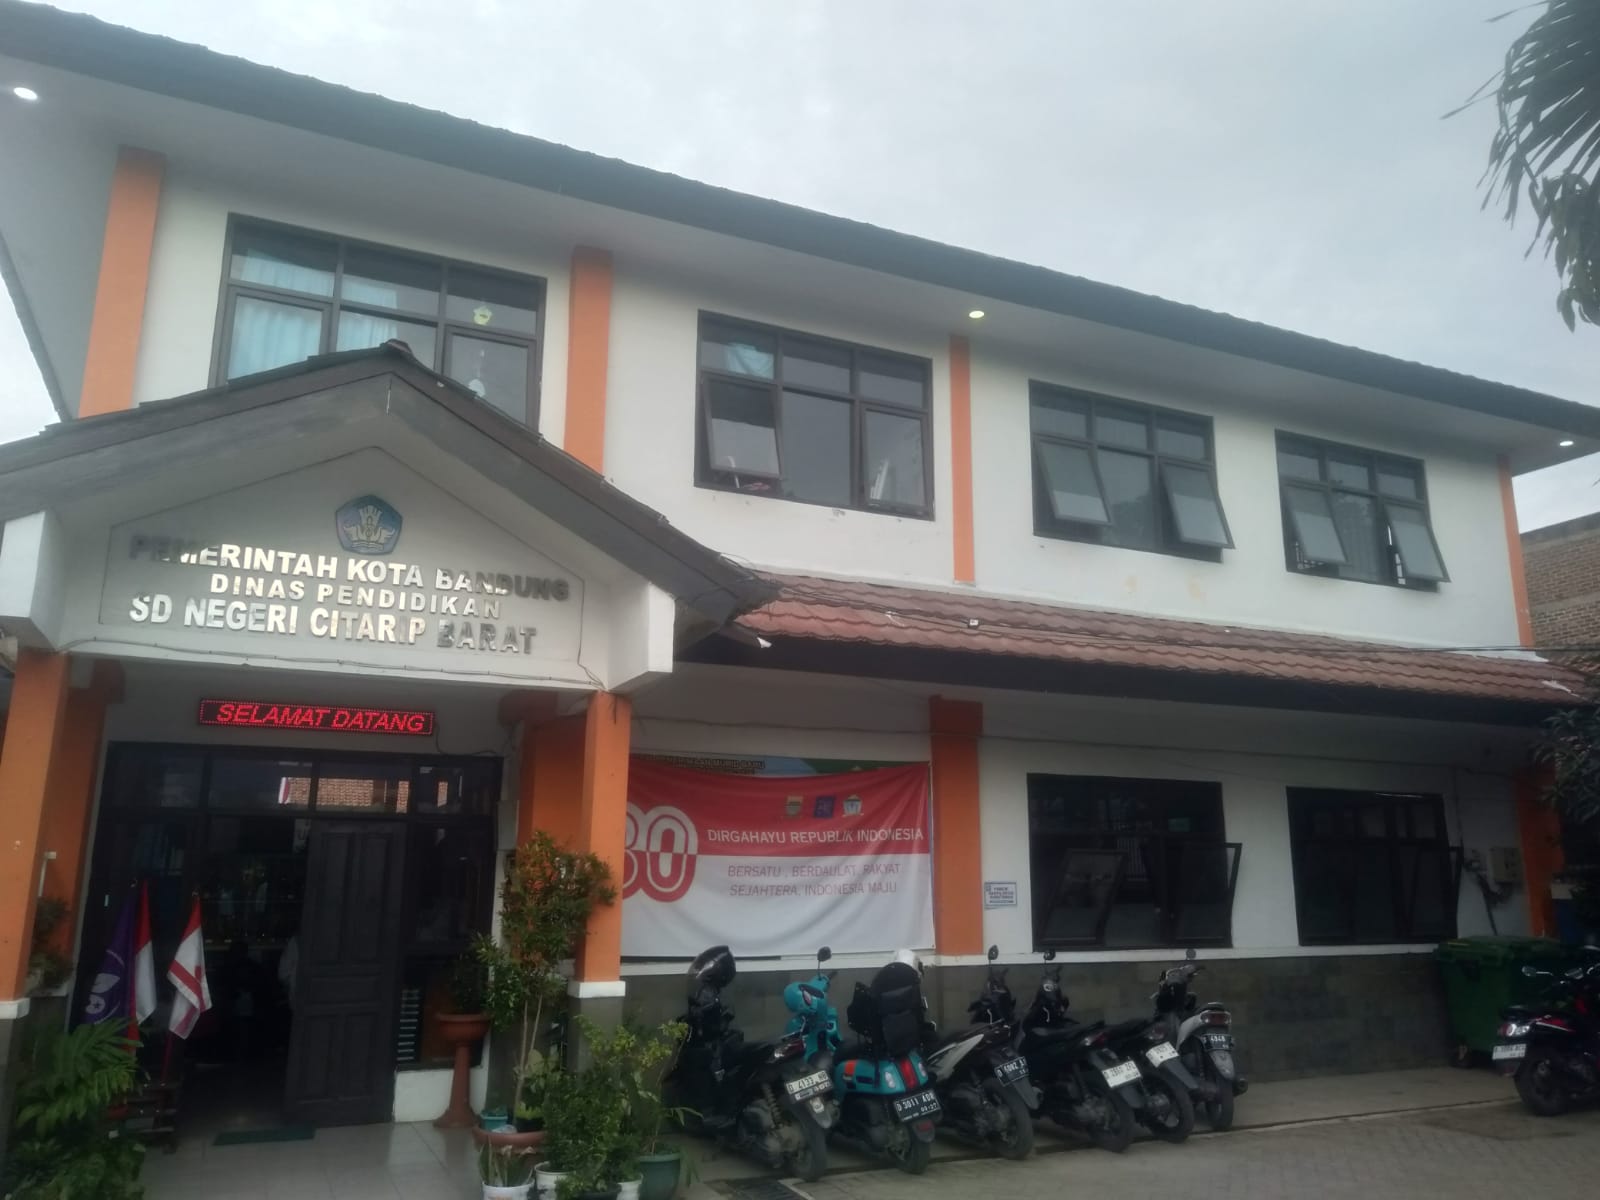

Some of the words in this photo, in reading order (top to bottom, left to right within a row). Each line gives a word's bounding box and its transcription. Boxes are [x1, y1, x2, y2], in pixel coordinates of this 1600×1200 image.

[129, 534, 339, 579] PEMERINTAH
[347, 558, 425, 588] KOTA
[435, 567, 570, 602] BANDUNG
[210, 573, 305, 600] DINAS
[317, 583, 500, 619] PENDIDIKAN
[129, 593, 173, 624] SD
[184, 597, 299, 634] NEGERI
[437, 618, 537, 655] BARAT
[216, 703, 331, 727] SELAMAT
[331, 709, 425, 733] DATANG
[707, 829, 786, 844] DIRGAHAYU
[790, 831, 854, 844] REPUBLIK
[857, 827, 924, 842] INDONESIA
[863, 863, 901, 874] RAKYAT
[804, 882, 865, 897] INDONESIA
[868, 880, 897, 895] MAJU
